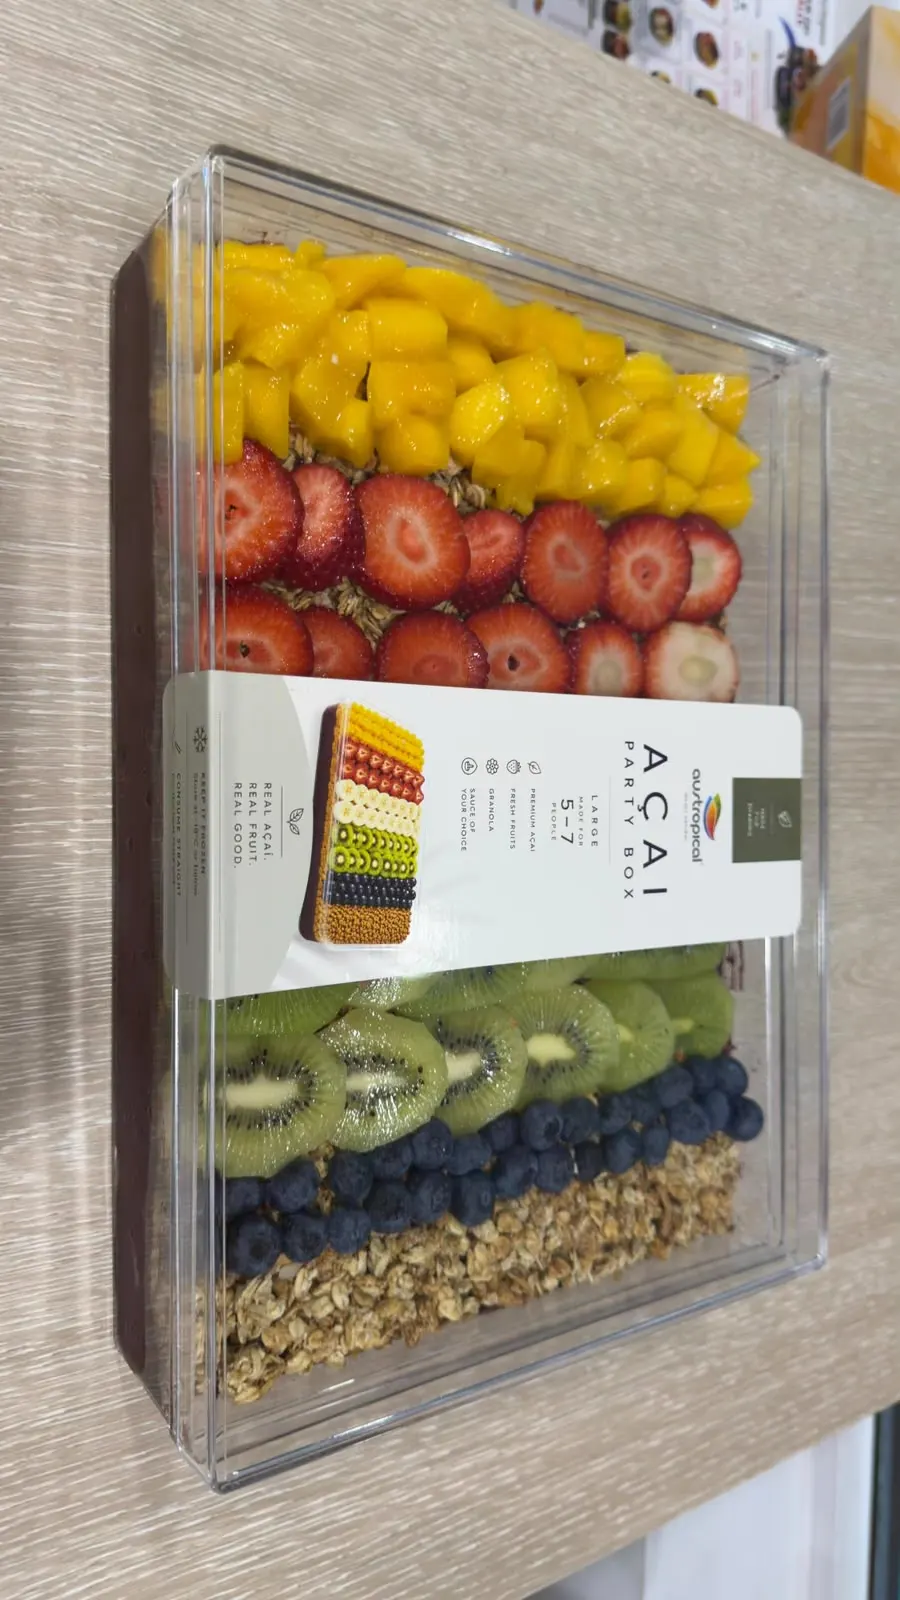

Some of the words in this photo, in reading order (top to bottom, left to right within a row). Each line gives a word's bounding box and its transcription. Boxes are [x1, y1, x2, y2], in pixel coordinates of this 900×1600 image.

[234, 782, 242, 817] REAL
[249, 782, 257, 817] REAL
[264, 782, 272, 816] REAL
[460, 788, 468, 813] YOUR
[625, 740, 634, 826] PARTY
[469, 820, 476, 833] OF
[590, 794, 599, 847] LARGE
[638, 743, 668, 895] AÇAI
[234, 823, 242, 869] GOOD.
[249, 823, 257, 866] FRUIT.
[624, 847, 633, 899] BOX
